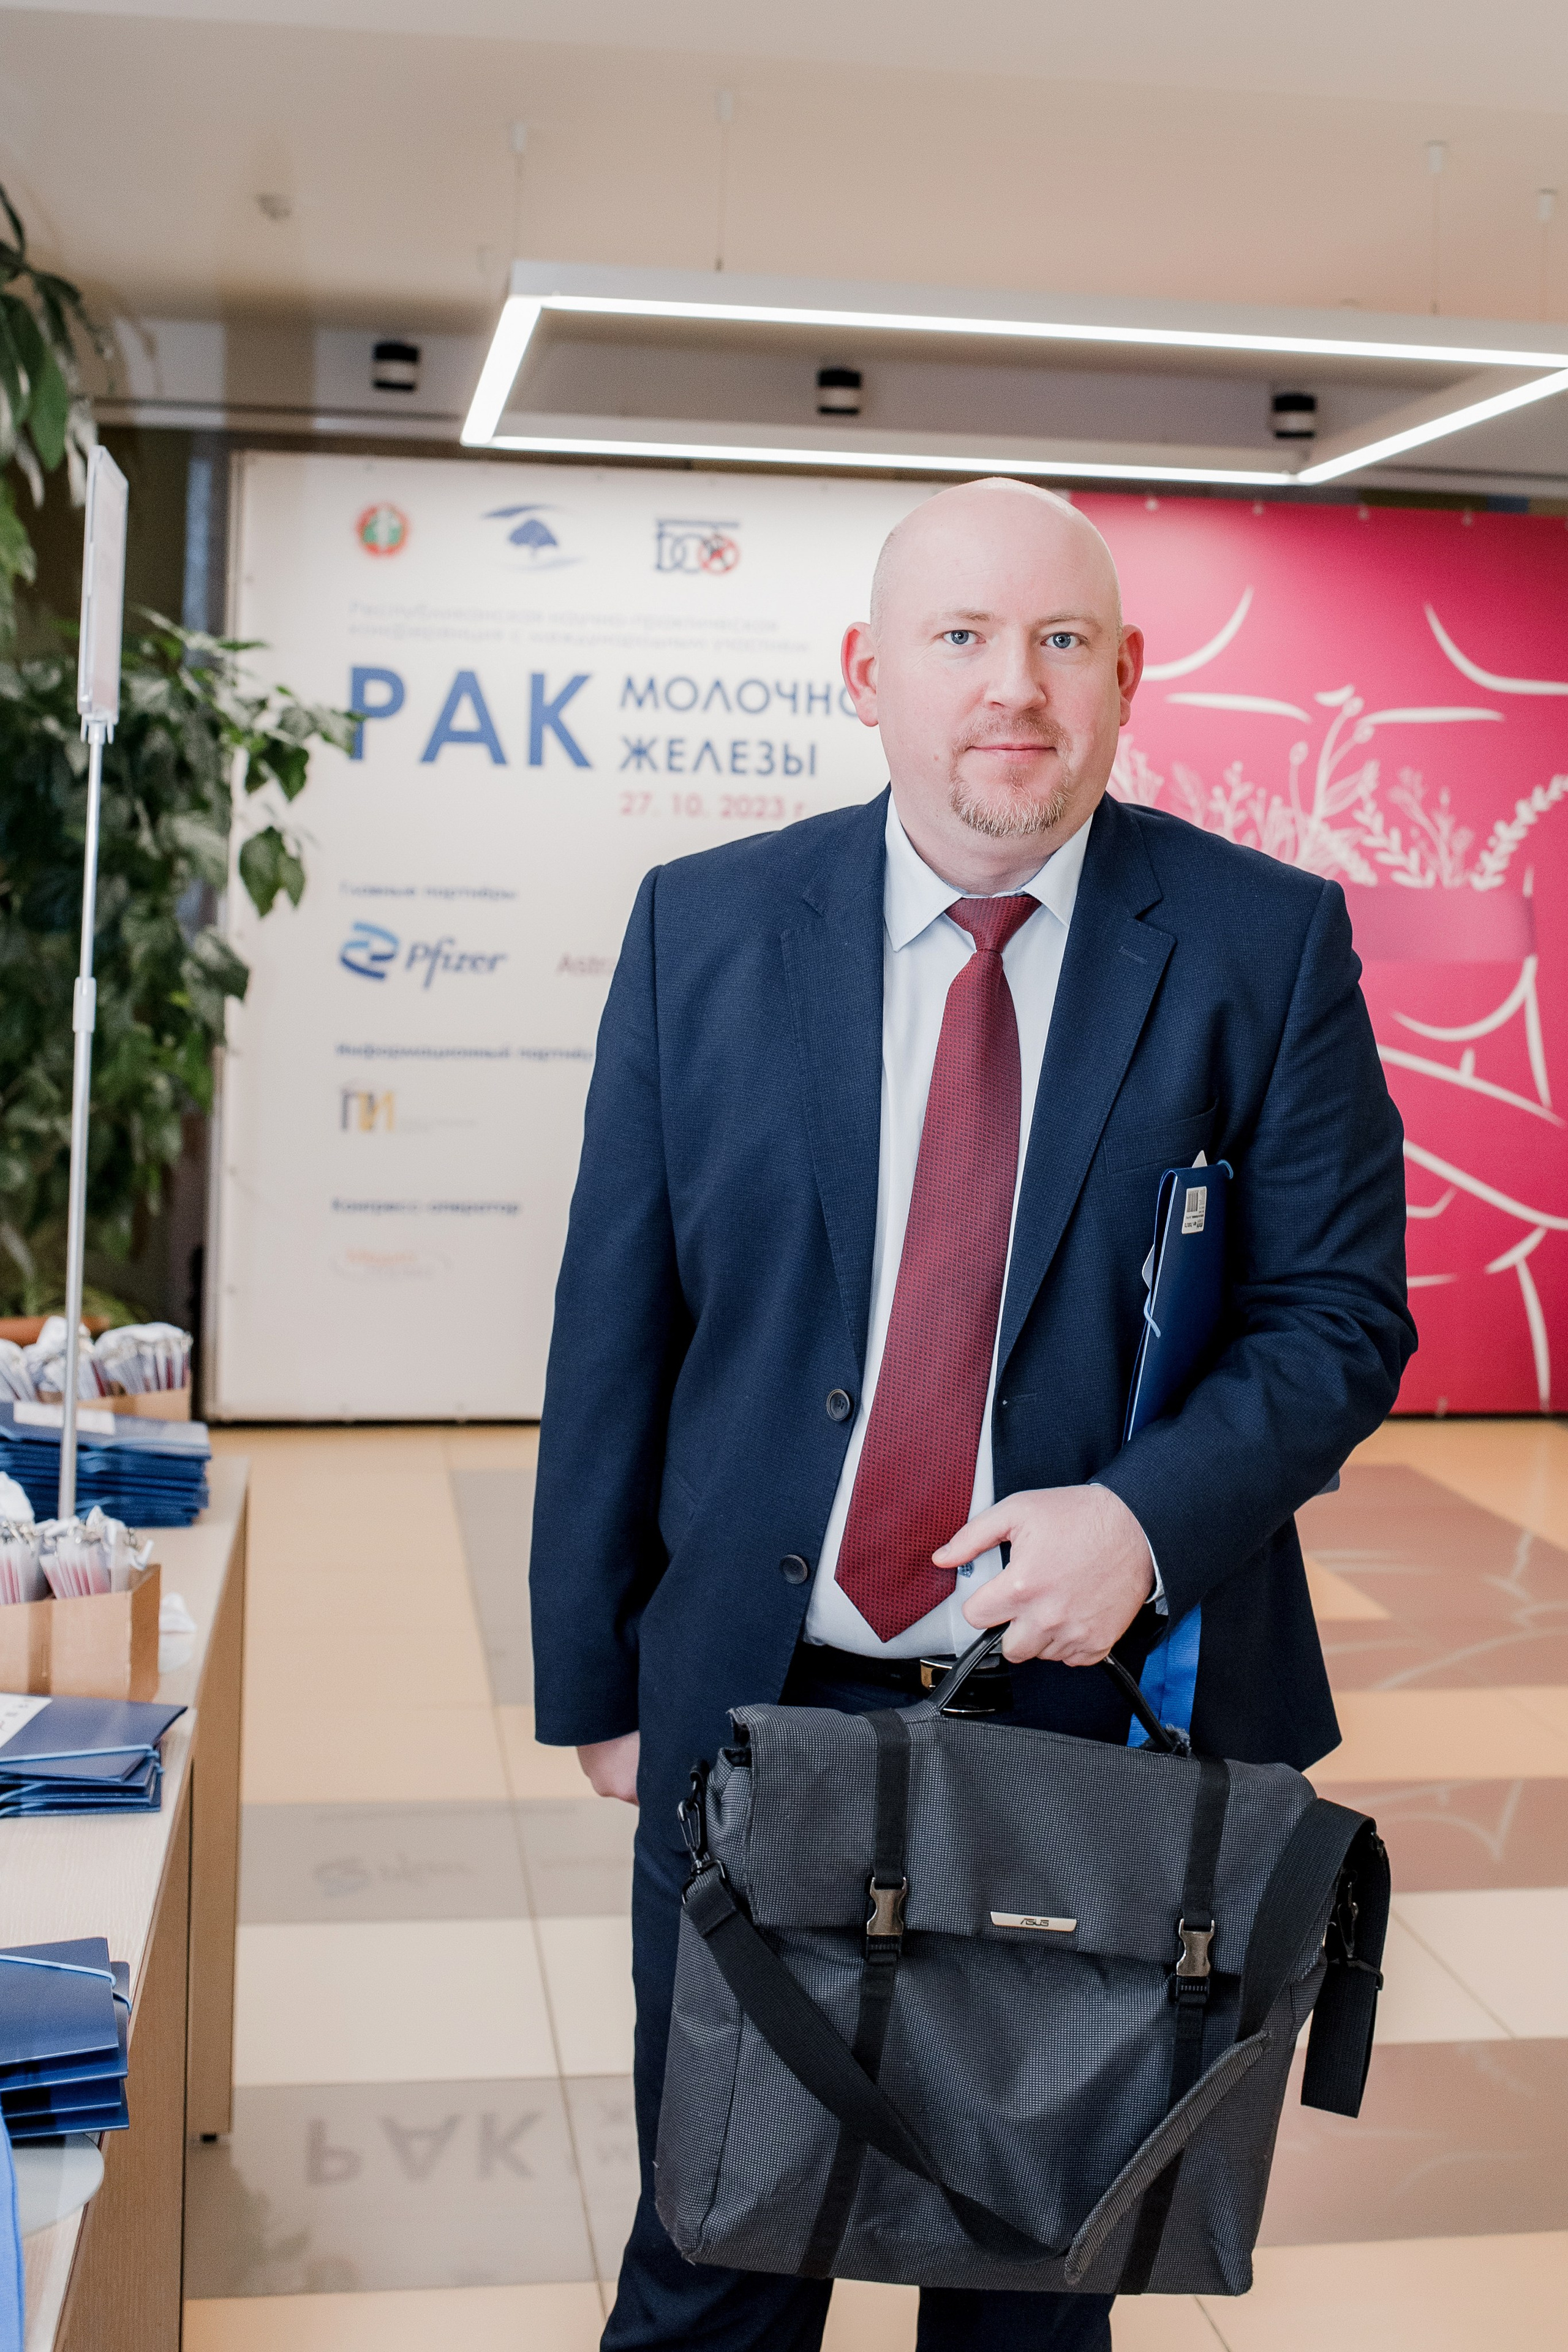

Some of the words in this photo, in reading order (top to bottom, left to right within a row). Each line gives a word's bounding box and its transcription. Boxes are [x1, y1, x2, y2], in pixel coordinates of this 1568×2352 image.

[350, 666, 592, 768] РАК
[620, 676, 859, 717] МОЛОЧНО
[620, 736, 816, 777] ЖЕЛЕЗЫ
[720, 795, 785, 820] 2023
[405, 937, 508, 990] Pfizer
[1020, 1918, 1049, 1927] ASUS
